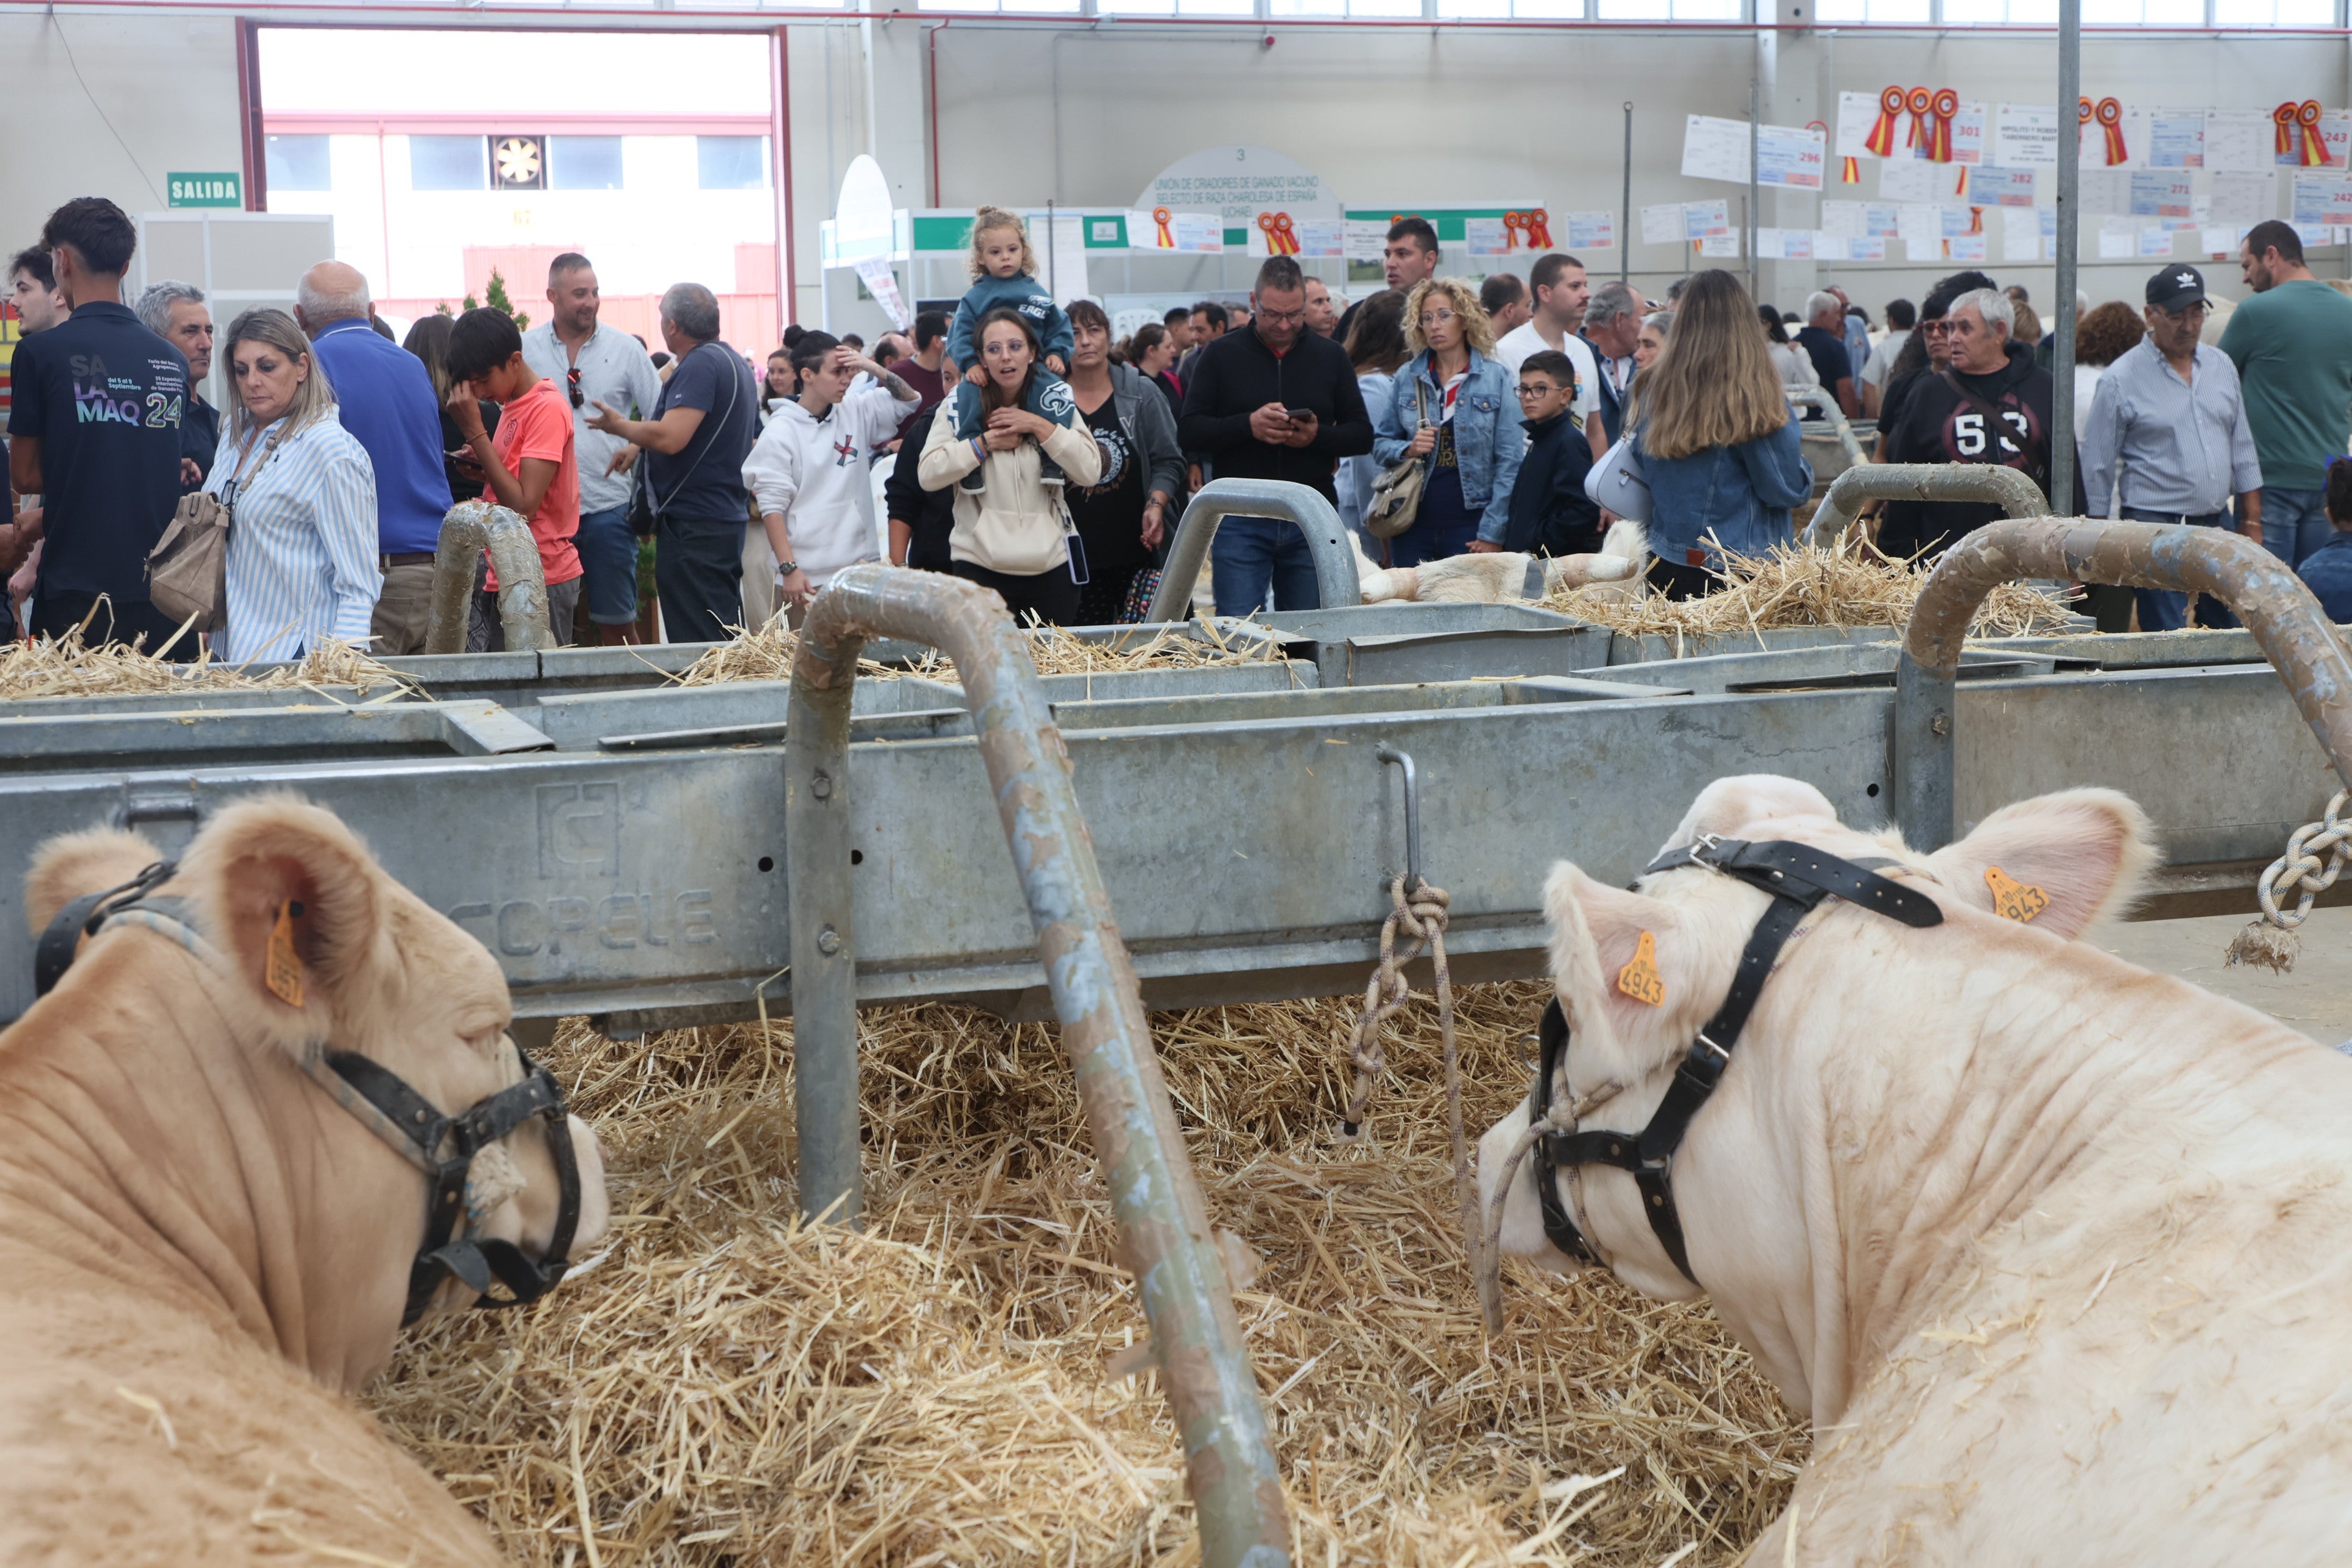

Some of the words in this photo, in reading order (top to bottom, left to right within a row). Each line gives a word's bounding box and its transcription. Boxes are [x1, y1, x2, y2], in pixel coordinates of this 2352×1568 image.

[1959, 125, 1980, 137] 301
[2325, 132, 2347, 142] 243
[1237, 148, 1246, 161] 3
[1799, 152, 1821, 163] 296
[1181, 178, 1192, 189] DE
[1194, 177, 1238, 189] CRIADORES
[1240, 177, 1250, 188] DE
[1253, 176, 1285, 188] GANADO
[1288, 175, 1319, 187] VACUNO
[2012, 173, 2032, 183] 282
[172, 181, 236, 199] SALIDA
[2171, 184, 2190, 195] 271
[1157, 193, 1191, 204] SELECTO
[1193, 192, 1204, 204] DE
[1206, 192, 1226, 203] RAZA
[1227, 191, 1274, 203] CHAROLESA
[1276, 191, 1285, 202] DE
[2334, 193, 2352, 202] 242
[1018, 304, 1047, 320] EAGL
[76, 399, 140, 426] MAQ
[145, 392, 182, 429] 24
[2001, 887, 2045, 923] 943
[1622, 969, 1663, 1004] 4943
